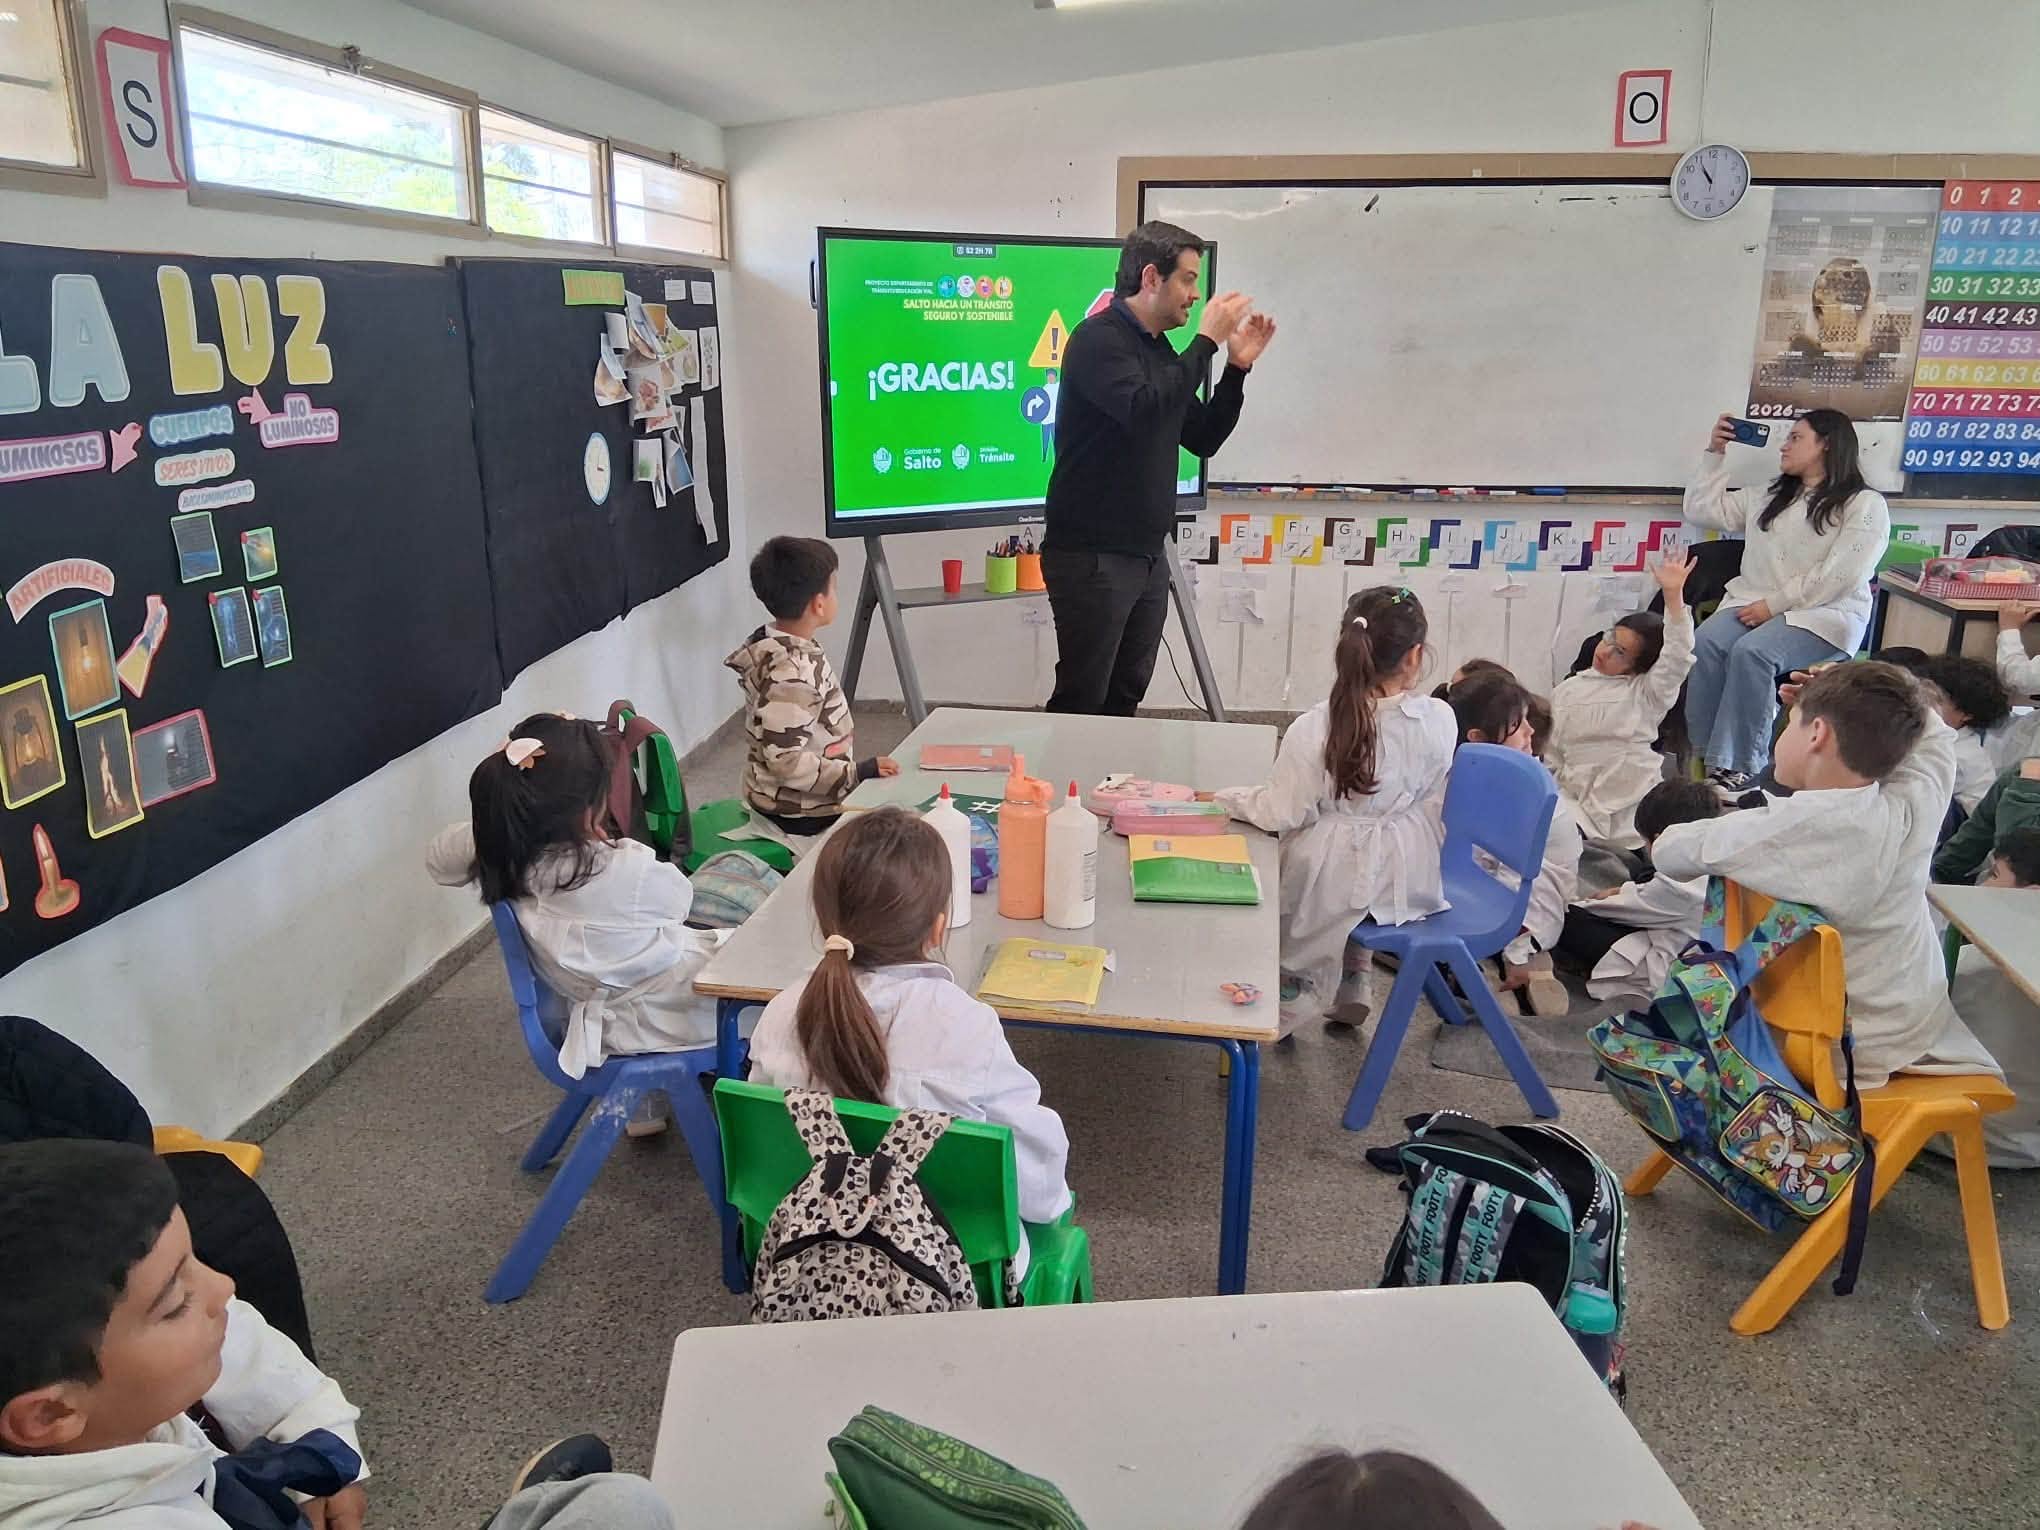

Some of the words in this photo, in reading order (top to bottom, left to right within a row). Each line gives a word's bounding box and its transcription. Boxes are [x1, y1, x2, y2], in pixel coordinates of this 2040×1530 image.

[122, 80, 157, 148] S
[1629, 91, 1659, 124] O
[1709, 150, 1718, 159] 12
[1686, 165, 1695, 173] 10
[1950, 186, 1963, 205] 0
[1980, 187, 1992, 205] 1
[2008, 187, 2022, 206] 2
[1942, 217, 1962, 235] 10
[1969, 218, 1991, 235] 11
[2000, 218, 2022, 235] 12
[2028, 218, 2040, 235] 1
[1936, 247, 1958, 264] 20
[1962, 247, 1988, 265] 21
[1992, 248, 2018, 265] 22
[1930, 276, 1954, 294] 30
[1958, 277, 1983, 295] 31
[1986, 277, 2014, 295] 32
[2016, 278, 2040, 295] 33
[904, 299, 930, 309] SALTO
[932, 300, 958, 309] HACIA
[960, 300, 972, 309] UN
[924, 311, 957, 320] SEGURO
[958, 312, 964, 320] Y
[967, 312, 1013, 320] SOSTENIBLE
[1926, 306, 1950, 323] 40
[1953, 306, 1978, 324] 41
[1982, 307, 2009, 325] 42
[2012, 308, 2038, 325] 43
[156, 265, 332, 395] LUZ
[1921, 335, 1944, 352] 50
[1949, 336, 1973, 353] 51
[1977, 336, 2004, 354] 52
[2007, 337, 2033, 354] 53
[868, 360, 1015, 401] ¡GRACIAS!
[1946, 364, 1969, 381] 61
[1974, 365, 1997, 382] 62
[2003, 366, 2028, 383] 63
[289, 401, 307, 417] NO
[1750, 403, 1793, 417] 2026
[1913, 393, 1937, 410] 70
[1941, 393, 1965, 410] 71
[1969, 394, 1993, 411] 72
[1997, 394, 2022, 411] 73
[2026, 395, 2040, 411] 7
[152, 406, 232, 443] CUERPOS
[264, 415, 334, 441] LUMINOSOS
[1909, 421, 1932, 438] 80
[1936, 422, 1960, 438] 81
[1964, 422, 1990, 439] 82
[1993, 423, 2017, 440] 83
[0, 438, 99, 474] UMINOSOS
[904, 456, 942, 470] Salto
[979, 452, 1015, 464] Tránsito
[1904, 449, 1928, 466] 90
[1931, 449, 1956, 466] 91
[1959, 450, 1984, 467] 92
[1987, 451, 2013, 468] 93
[2017, 452, 2040, 468] 94
[160, 459, 199, 480] SERES
[200, 453, 231, 473] VIVOS
[1024, 526, 1033, 538] A
[1183, 528, 1192, 539] D
[1237, 526, 1246, 537] E
[1290, 521, 1297, 532] F
[1340, 523, 1350, 535] G
[1393, 530, 1402, 541] H
[1500, 528, 1507, 539] J
[1553, 533, 1563, 545] K
[1608, 533, 1617, 545] L
[1663, 533, 1676, 545] M
[11, 563, 111, 614] ARTIFICIALES
[1426, 1188, 1443, 1225] FOOTY
[1471, 1231, 1489, 1267] FOOTY
[1482, 1191, 1504, 1229] FOOTY
[1420, 1226, 1434, 1262] FOOTY
